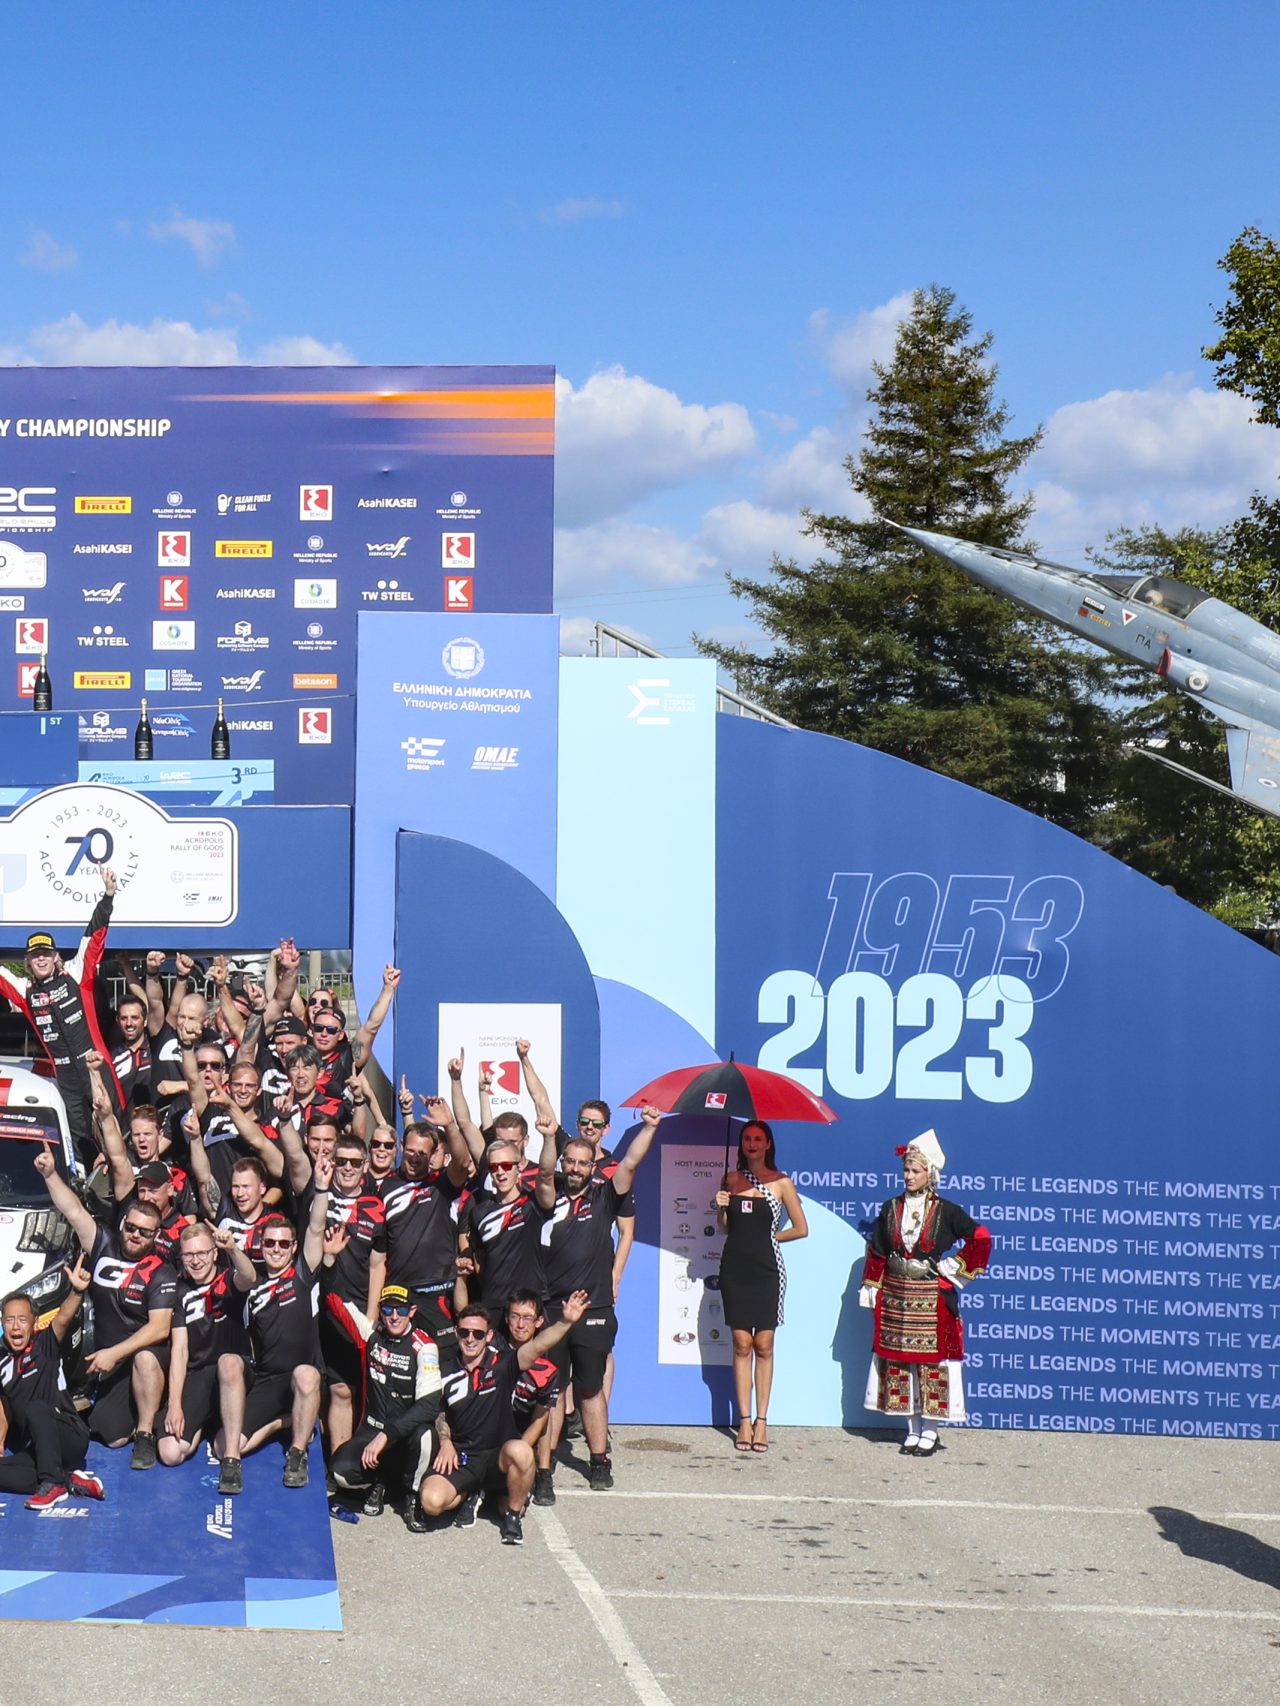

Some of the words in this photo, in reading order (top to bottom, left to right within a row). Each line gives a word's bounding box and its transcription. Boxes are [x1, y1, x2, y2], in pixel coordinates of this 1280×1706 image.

[16, 419, 171, 438] CHAMPIONSHIP
[81, 501, 125, 510] PIRELLI
[235, 496, 254, 504] CLEAN
[254, 494, 271, 502] FUELS
[358, 499, 417, 508] AsahiKASEI
[235, 504, 245, 512] FOR
[246, 504, 256, 512] ALL
[74, 545, 132, 553] AsahiKASEI
[222, 545, 266, 554] PIRELLI
[216, 589, 275, 598] AsahiKASEI
[362, 592, 379, 600] TW
[381, 592, 414, 600] STEEL
[77, 637, 95, 646] TW
[97, 637, 129, 646] STEEL
[295, 677, 332, 685] betsson
[393, 682, 452, 697] ΕΛΛΗΝΙΚΗ
[455, 686, 532, 699] ΔΗΜΟΚΡΑΤΙΑ
[403, 697, 458, 712] Υπουργείο
[461, 700, 520, 714] Αθλητισμού
[474, 746, 519, 762] OMAE
[51, 806, 78, 828] 1953
[97, 805, 127, 828] 2023
[64, 828, 113, 876] 70
[811, 872, 1085, 1004] 1953
[757, 970, 1034, 1103] 2023
[786, 1171, 877, 1188] MOMENTS
[940, 1175, 985, 1191] EARS
[991, 1176, 1026, 1192] THE
[1032, 1177, 1118, 1194] LEGENDS
[1123, 1180, 1159, 1196] THE
[1165, 1182, 1264, 1200] MOMENTS
[970, 1205, 1055, 1222] LEGENDS
[1061, 1208, 1096, 1223] THE
[1102, 1209, 1201, 1227] MOMENTS
[1206, 1212, 1242, 1228] THE
[93, 1254, 163, 1289] GR
[1061, 1266, 1096, 1282] THE
[1102, 1268, 1201, 1286] MOMENTS
[1206, 1272, 1242, 1288] THE
[968, 1323, 1054, 1340] LEGENDS
[1060, 1326, 1095, 1343] THE
[1101, 1328, 1200, 1346] MOMENTS
[1205, 1331, 1241, 1348] THE
[967, 1382, 1053, 1400] LEGENDS
[1059, 1385, 1094, 1401] THE
[1100, 1387, 1199, 1406] MOMENTS
[1205, 1391, 1240, 1408] THE
